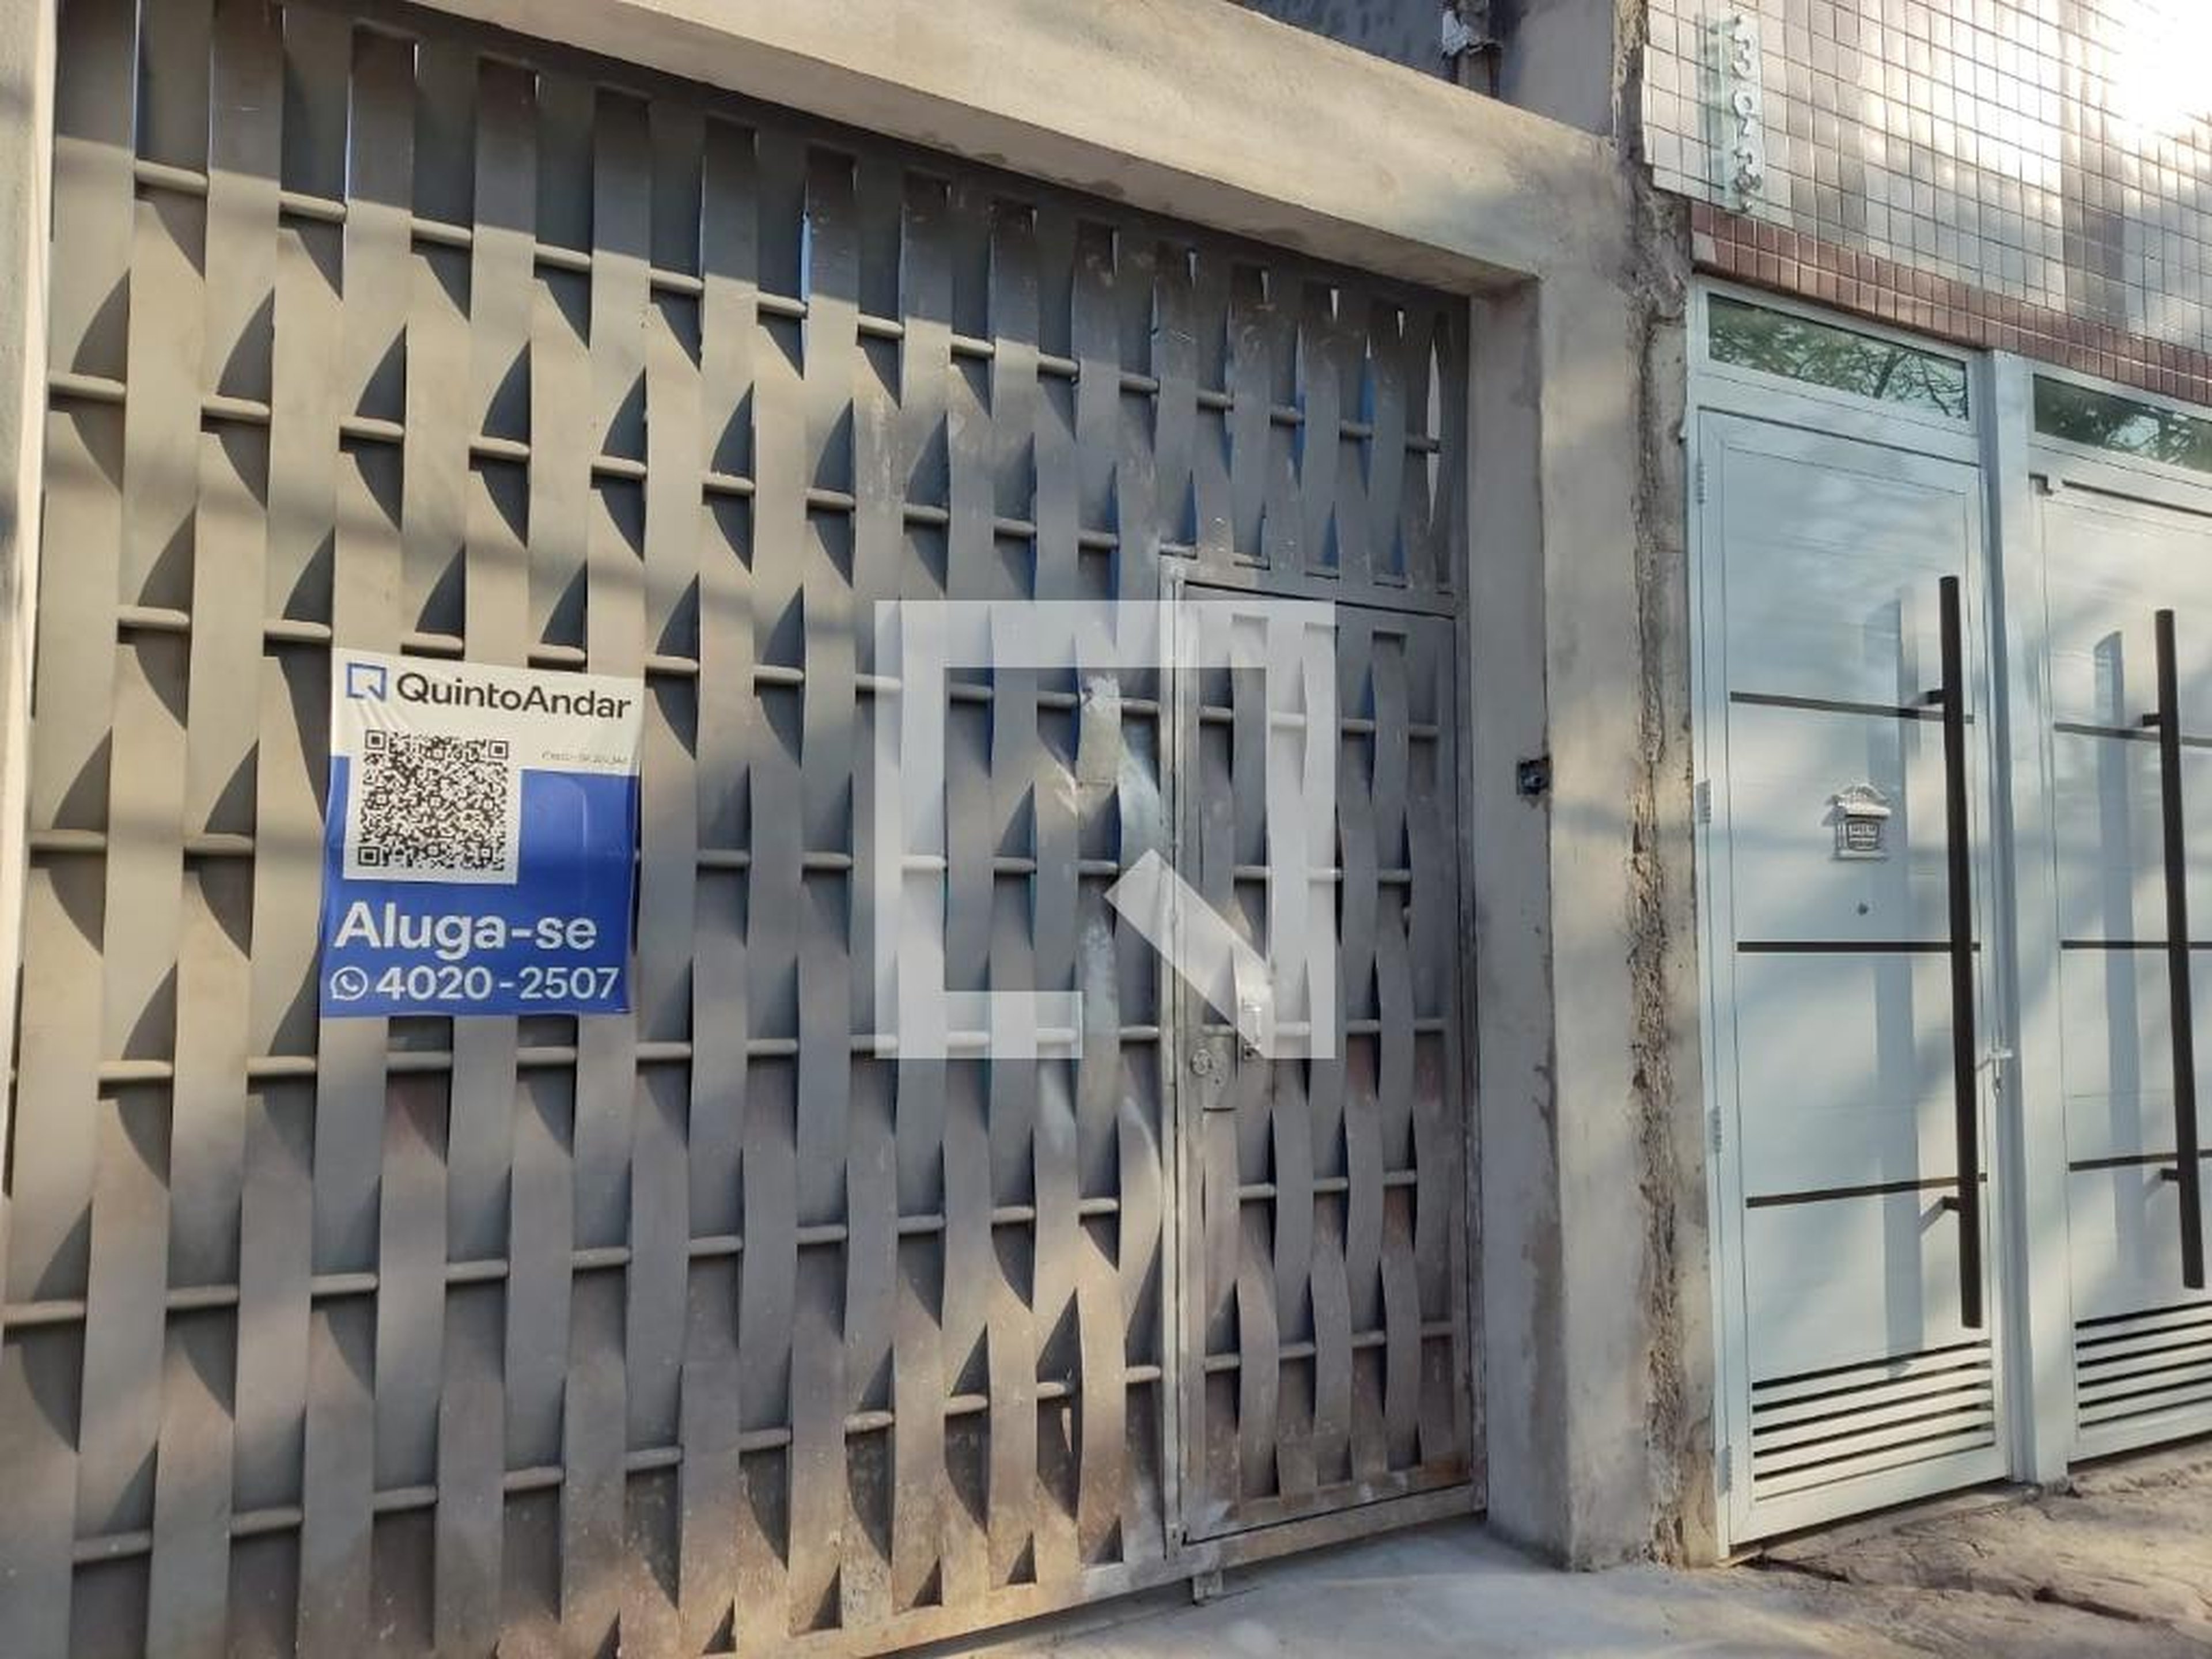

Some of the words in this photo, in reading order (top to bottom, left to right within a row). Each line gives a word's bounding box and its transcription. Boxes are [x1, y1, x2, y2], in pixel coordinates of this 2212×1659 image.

[396, 673, 631, 719] QuintoAndar
[334, 901, 597, 961] Aluga-se
[376, 966, 620, 1001] 4020-2507
